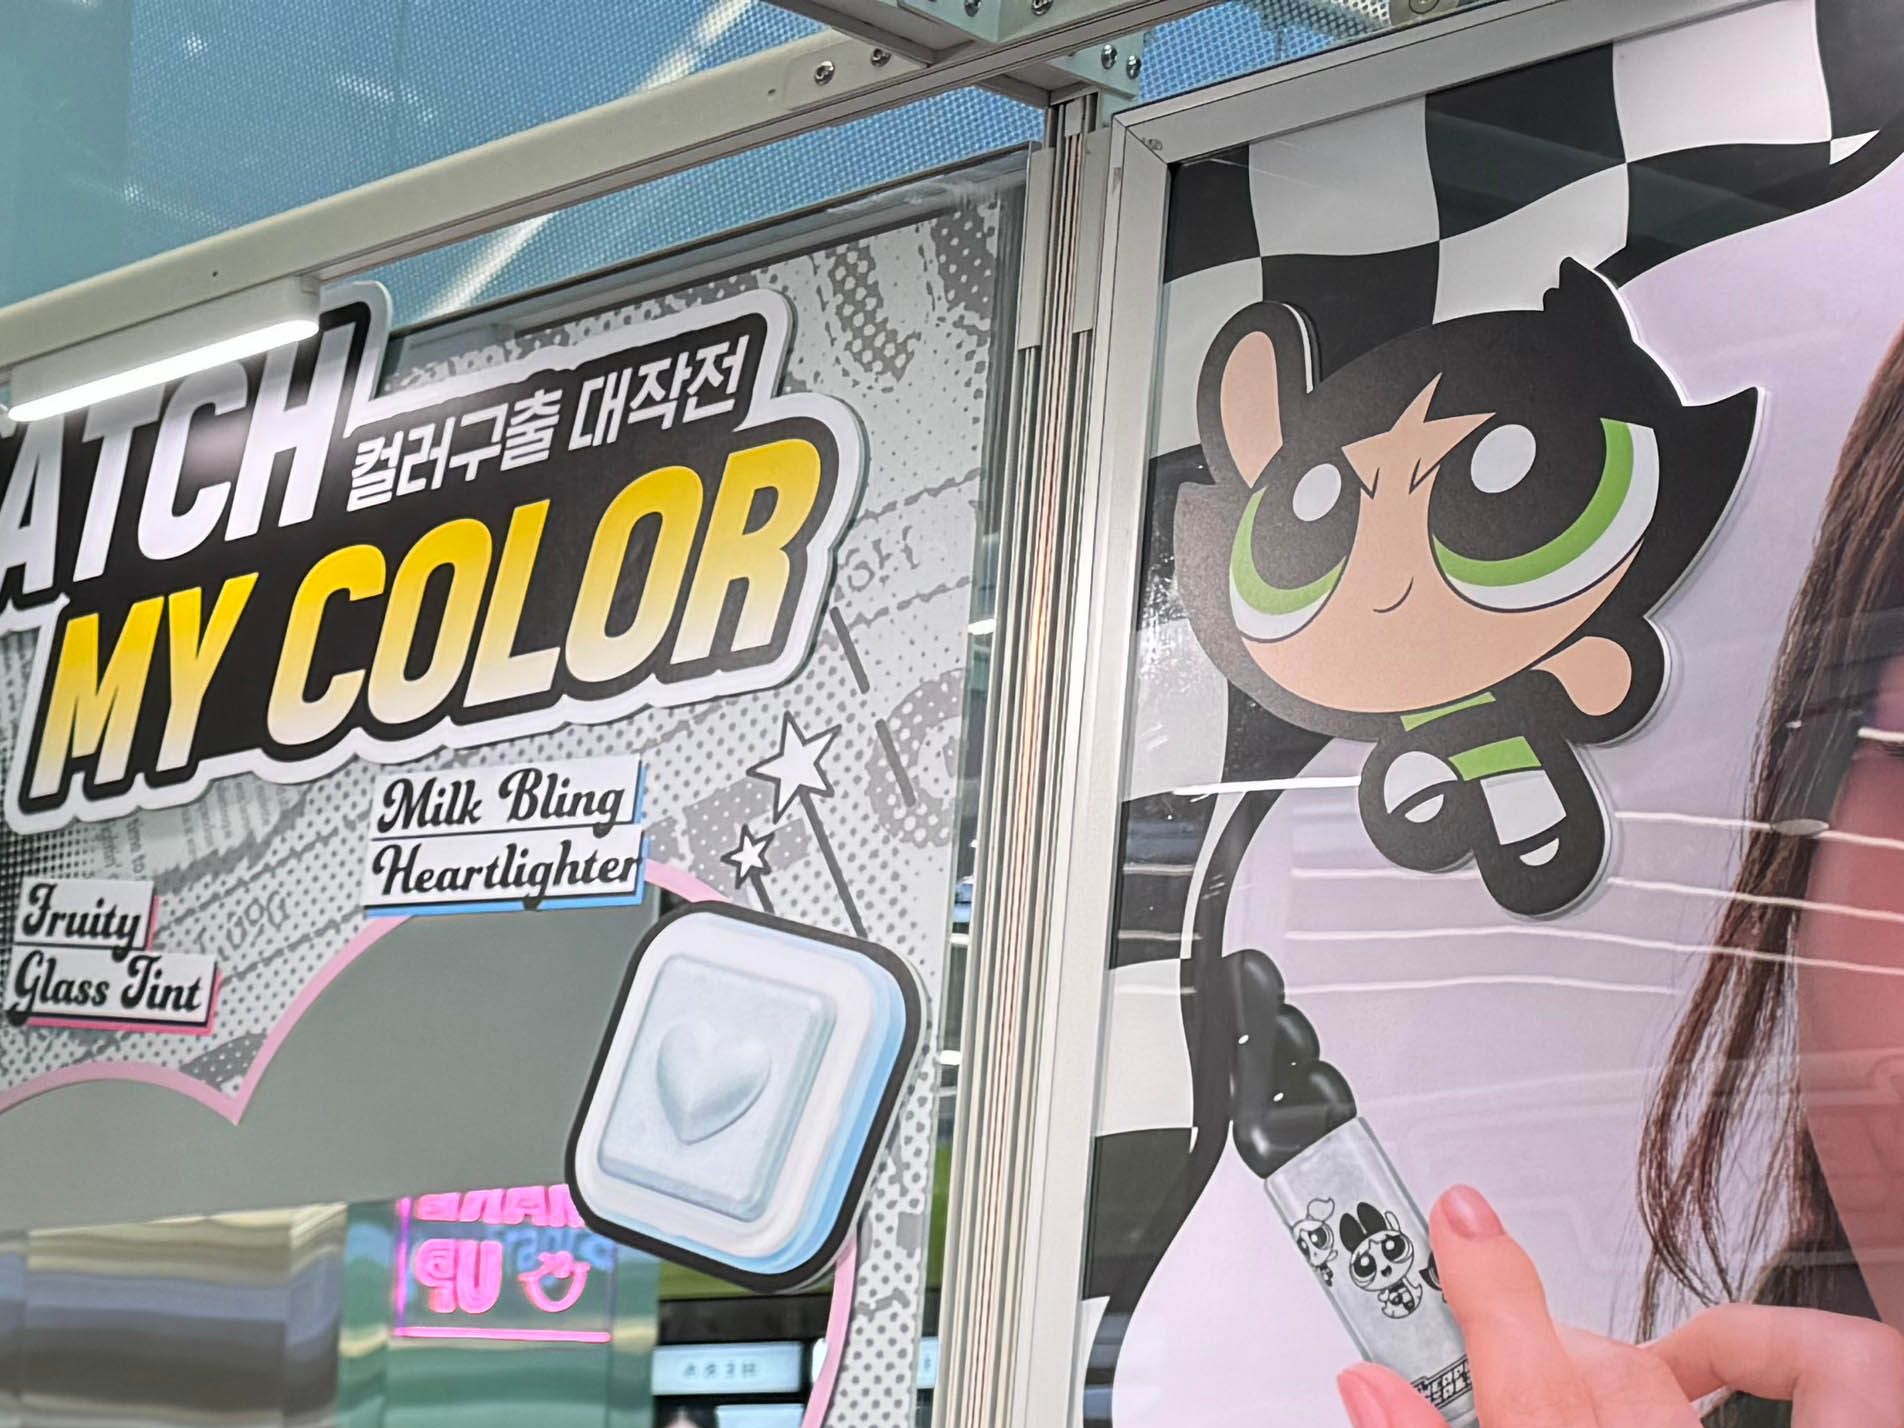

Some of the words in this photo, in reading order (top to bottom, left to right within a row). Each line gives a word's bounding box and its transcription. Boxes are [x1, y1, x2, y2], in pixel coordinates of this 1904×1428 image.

[345, 397, 561, 514] 컬러구출
[568, 336, 752, 455] 대작전
[31, 573, 261, 800] MY
[267, 437, 823, 749] COLOR
[377, 776, 483, 833] Milk
[500, 767, 626, 838] Bling
[373, 830, 642, 912] Heartlighter
[21, 883, 143, 960] Fruity
[8, 950, 109, 1025] Glass
